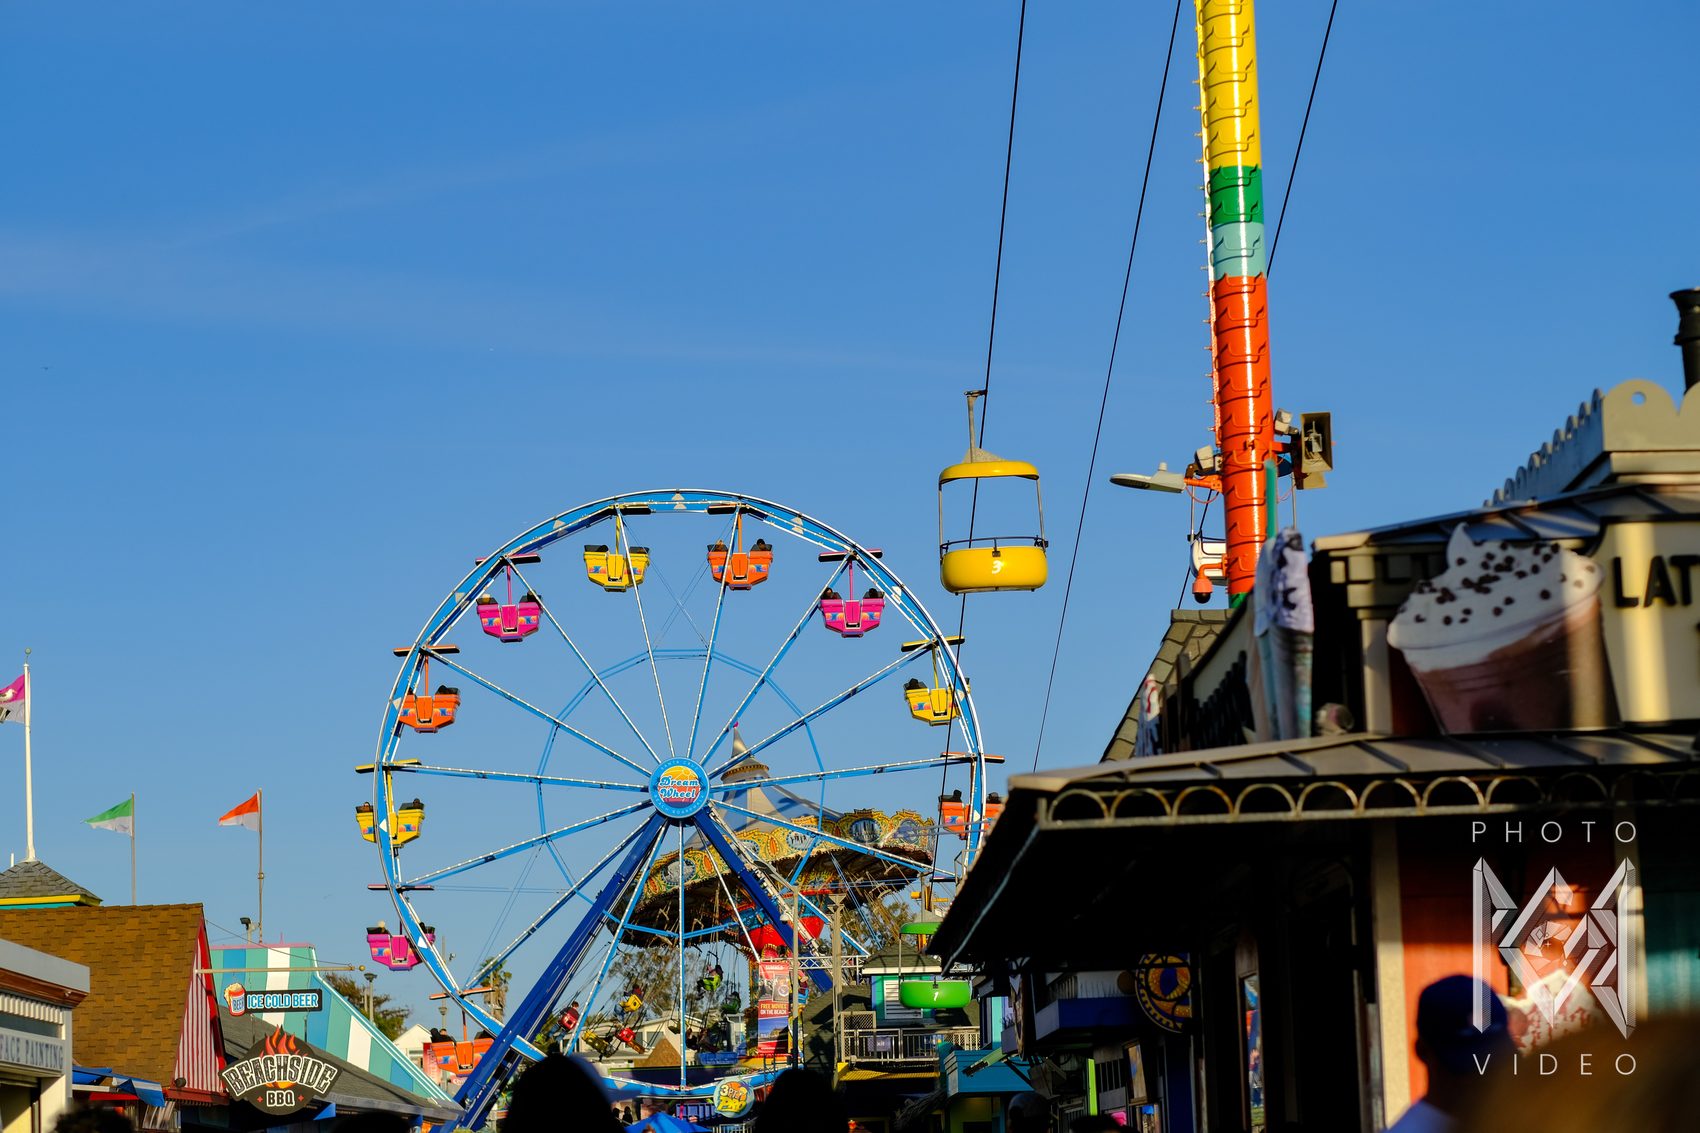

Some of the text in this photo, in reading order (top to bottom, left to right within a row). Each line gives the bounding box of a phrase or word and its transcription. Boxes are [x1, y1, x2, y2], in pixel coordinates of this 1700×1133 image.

[659, 775, 699, 786] Dream
[660, 787, 696, 799] Wheel
[247, 993, 319, 1009] ICE COLD BEER
[25, 1040, 64, 1069] PAINTING
[222, 1054, 338, 1096] BEACHSIDE
[265, 1090, 296, 1107] BBQ
